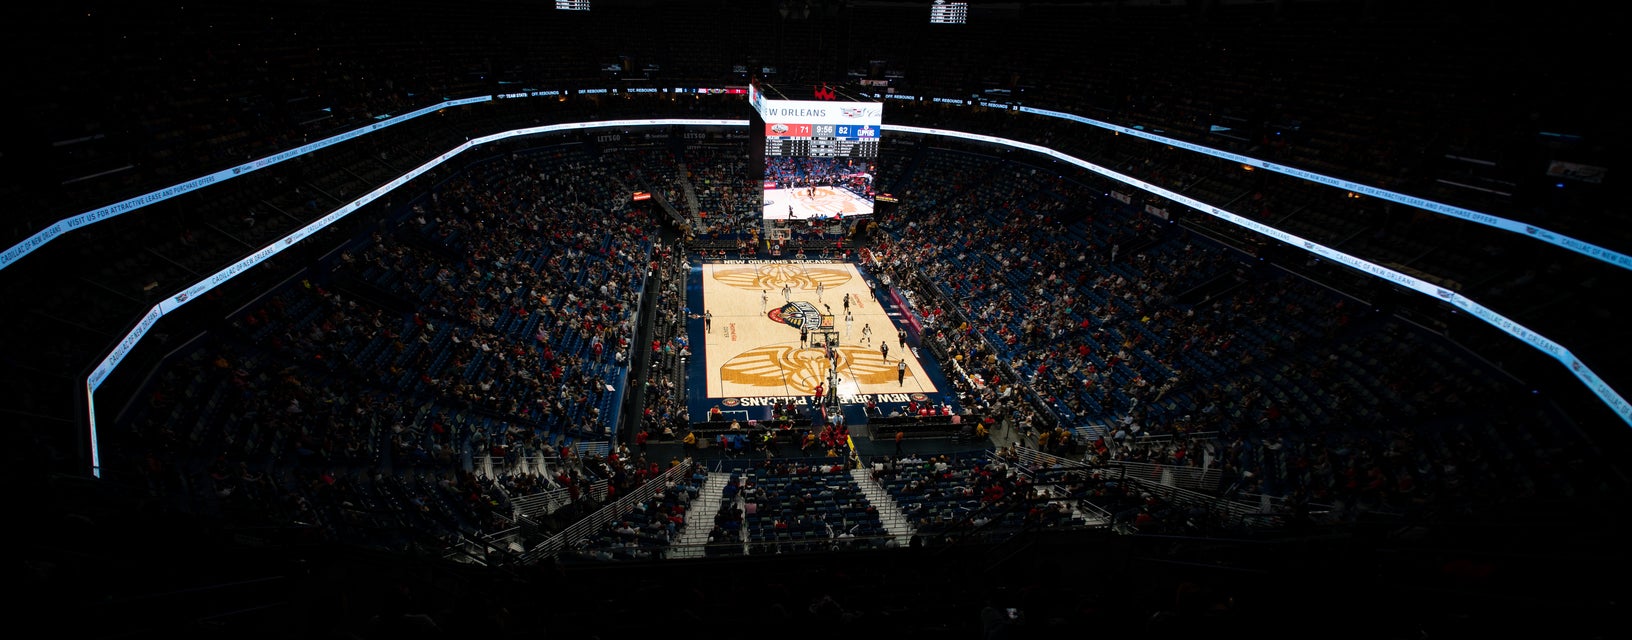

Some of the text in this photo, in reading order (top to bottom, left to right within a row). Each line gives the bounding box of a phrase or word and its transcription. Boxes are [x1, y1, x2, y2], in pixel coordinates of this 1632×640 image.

[782, 108, 826, 117] ORLEANS
[838, 126, 848, 134] 82
[1, 246, 25, 264] CADILLAC
[32, 235, 42, 246] NEW
[42, 225, 61, 240] ORLEANS
[68, 216, 85, 228] VISIT
[87, 212, 96, 221] US
[98, 208, 109, 218] FOR
[110, 197, 145, 214] ATTRACTIVE
[145, 193, 162, 203] LEASE
[163, 189, 173, 197] AND
[174, 181, 198, 194] PURCHASE
[199, 176, 215, 185] OFFERS
[1407, 197, 1424, 206] LEASE
[1425, 202, 1438, 210] AND
[1438, 205, 1471, 218] PURCHASE
[1472, 213, 1497, 224] OFFERS
[1562, 237, 1590, 253] CADILLAC
[1602, 250, 1616, 262] NEW
[212, 266, 237, 285] CADILLAC
[243, 257, 254, 268] NEW
[254, 247, 274, 262] ORLEANS
[1336, 253, 1362, 267] CADILLAC
[1372, 266, 1385, 276] NEW
[1386, 271, 1415, 287] ORLEANS
[109, 341, 130, 366] CADILLAC
[143, 310, 158, 330] ORLEANS
[1474, 306, 1560, 356] CADILLAC OF NEW ORLEANS
[878, 393, 911, 403] NEW
[1597, 384, 1631, 416] CADILLAC OF
